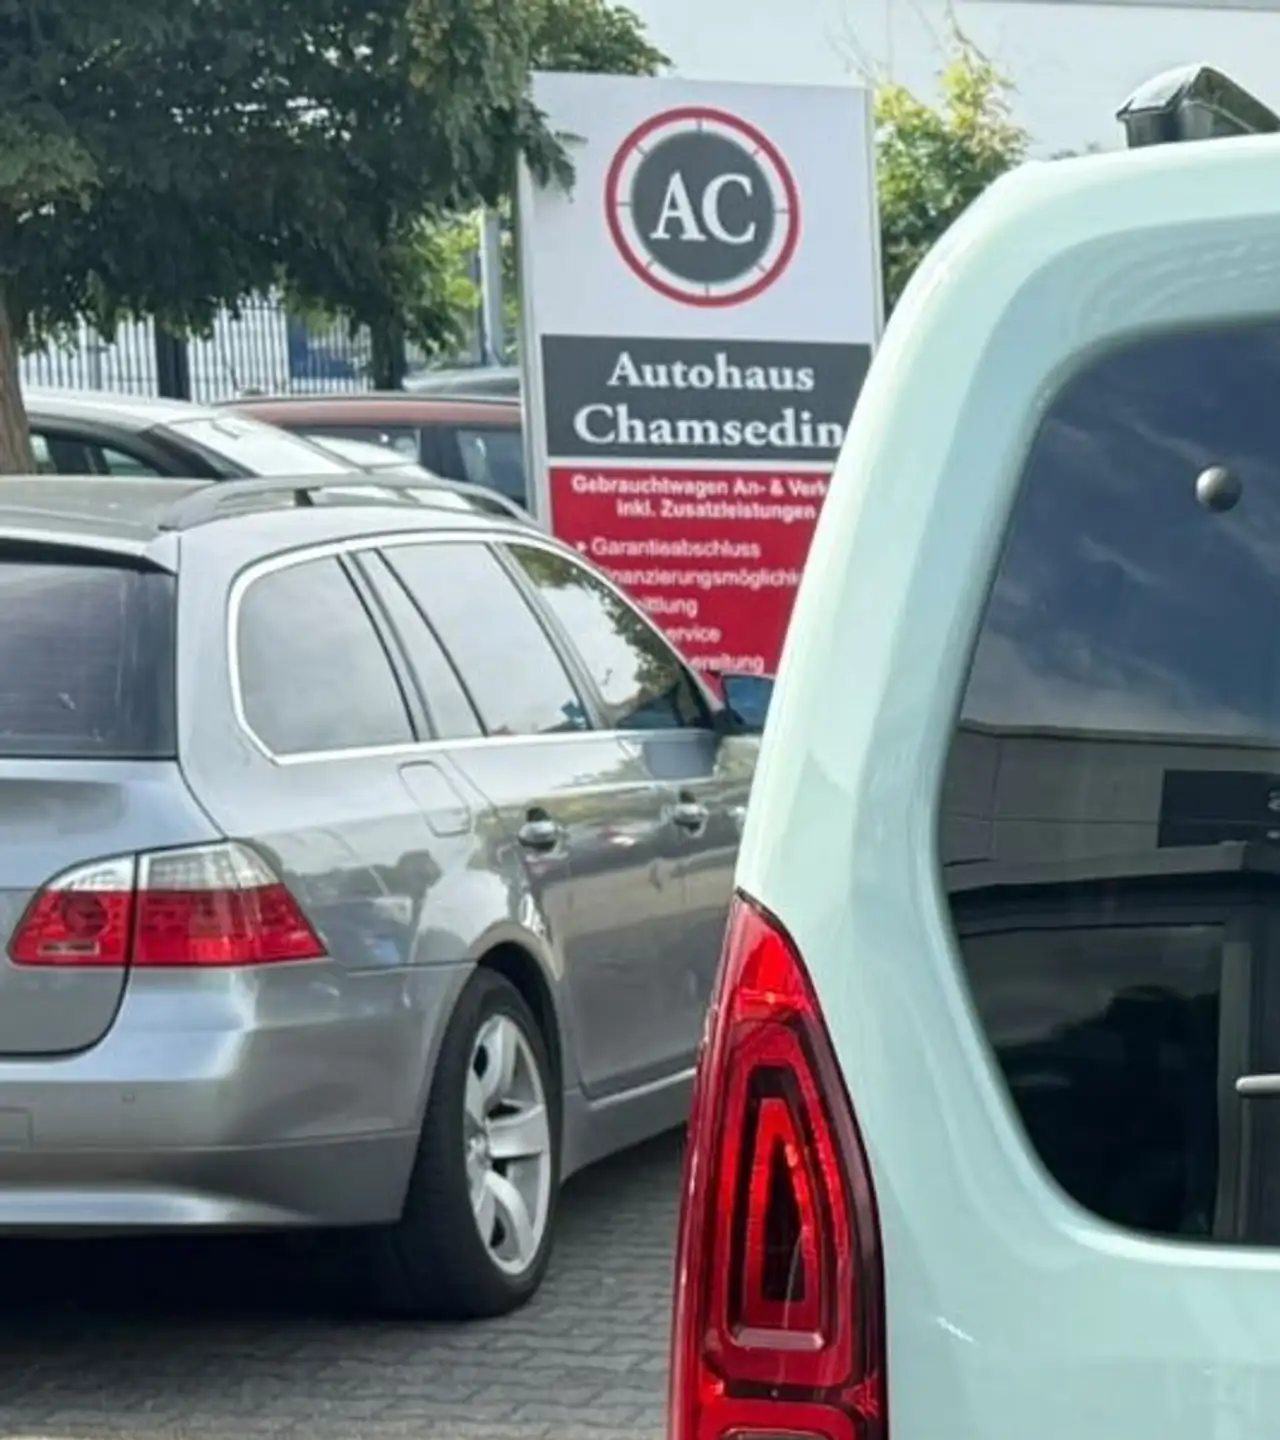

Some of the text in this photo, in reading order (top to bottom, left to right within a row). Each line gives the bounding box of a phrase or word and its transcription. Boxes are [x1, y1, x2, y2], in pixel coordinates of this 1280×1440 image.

[649, 171, 756, 246] AC
[606, 351, 815, 391] Autohaus
[573, 404, 846, 448] Chamsedin
[571, 474, 728, 497] Gebrauchtwagen
[733, 479, 766, 496] An-
[769, 478, 784, 497] &
[661, 499, 816, 523] Zusatzleistungen
[591, 536, 761, 558] Garantieabschluss
